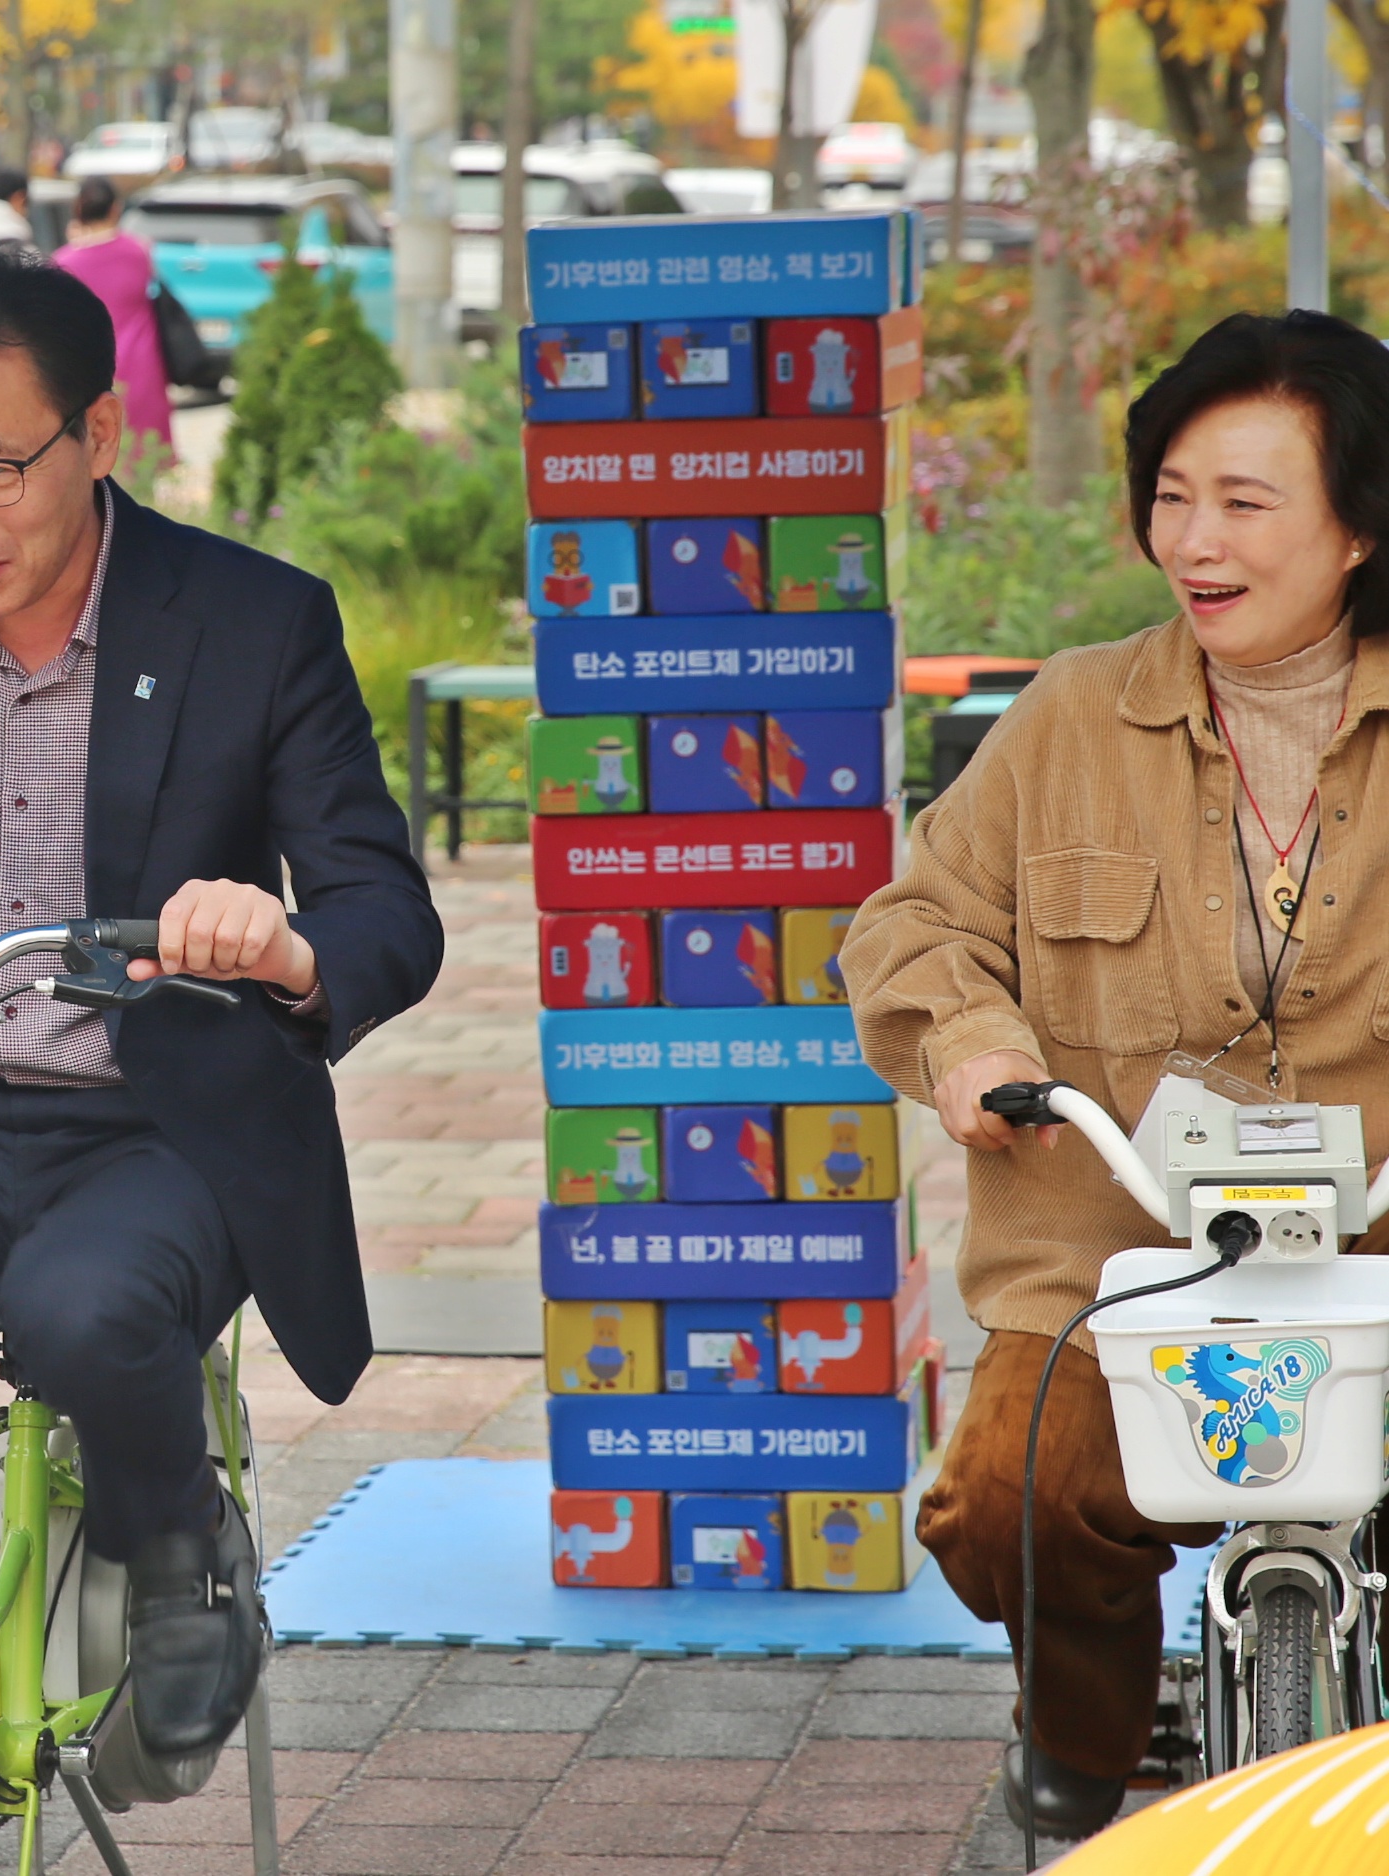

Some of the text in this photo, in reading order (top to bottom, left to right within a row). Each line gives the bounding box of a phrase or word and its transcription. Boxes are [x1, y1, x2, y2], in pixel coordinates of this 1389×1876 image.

[545, 252, 873, 288] 기후변화 관련 영상, 책 보기
[543, 454, 622, 483] 양치할
[670, 452, 750, 480] 양치컵
[757, 449, 863, 477] 사용하기
[573, 647, 853, 679] 탄소 포인트제 가입하기
[567, 842, 854, 875] 안쓰는 콘센트 코드 뽑기
[556, 1040, 866, 1070] 기후변화 관련 영상, 책 보
[571, 1236, 606, 1265] 넌,
[612, 1235, 638, 1263] 불
[679, 1235, 734, 1263] 때가
[739, 1234, 793, 1262] 제일
[800, 1234, 864, 1262] 예뻐!
[1216, 1354, 1302, 1452] AMICA 18
[588, 1428, 866, 1457] 탄소 포인트제 가입하기
